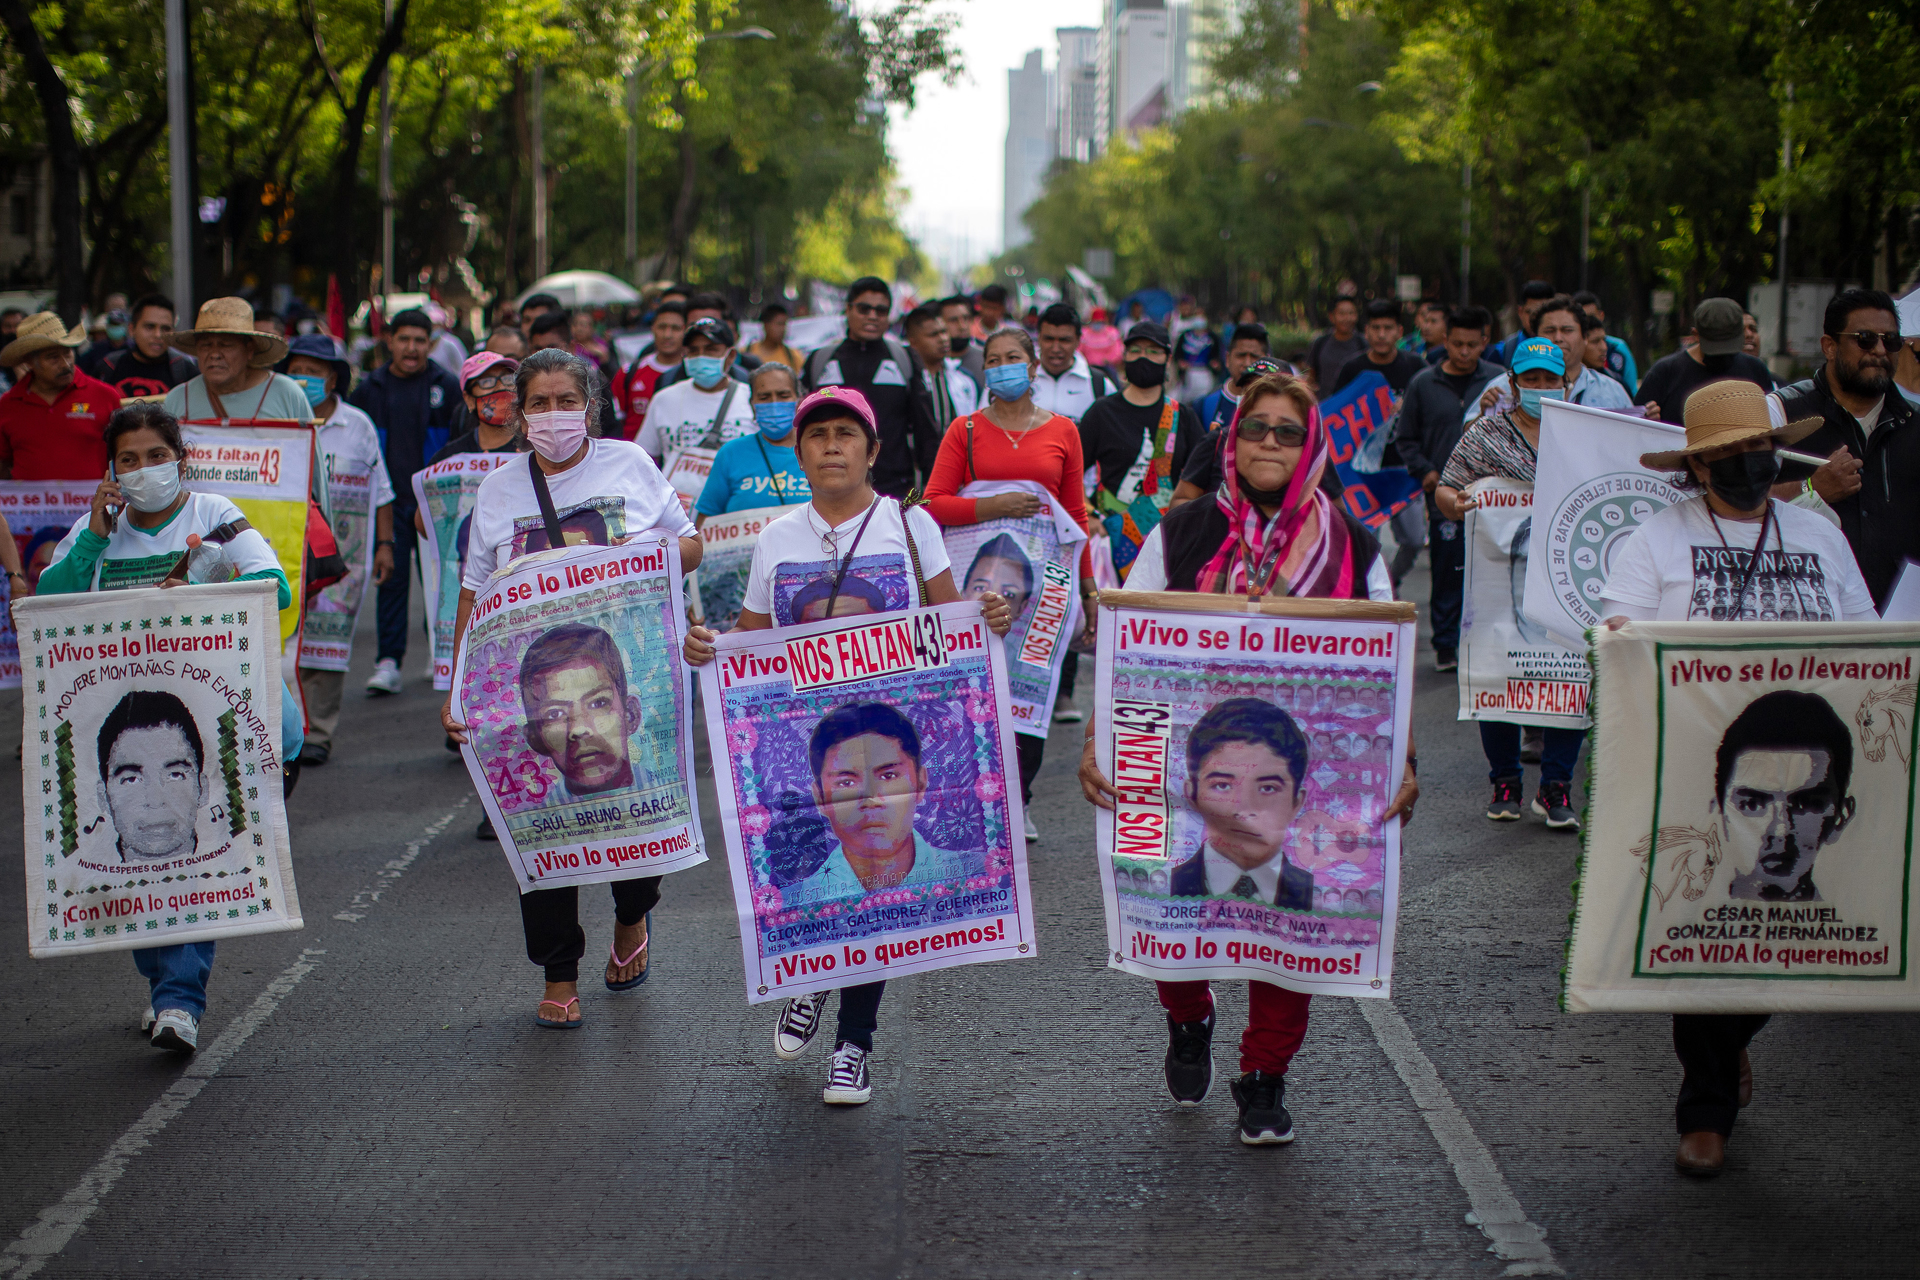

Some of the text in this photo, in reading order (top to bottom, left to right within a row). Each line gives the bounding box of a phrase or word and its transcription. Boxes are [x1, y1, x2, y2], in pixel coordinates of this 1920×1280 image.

[186, 465, 258, 482] Dónde están
[187, 448, 280, 485] Nos faltan 43
[325, 453, 336, 483] 3!
[329, 472, 370, 487] varon!
[425, 459, 489, 479] ¡Vivo se
[677, 460, 711, 476] ¡Vivo
[22, 490, 41, 507] se
[45, 491, 58, 507] lo
[63, 490, 94, 507] lleva
[1478, 489, 1517, 509] ¡Vivo
[744, 521, 761, 536] se
[470, 548, 664, 630] ¡Vivo se lo llevaron!
[1044, 561, 1071, 587] 43!
[577, 598, 602, 610] quiero
[604, 590, 625, 603] saber
[628, 586, 647, 597] dónde
[649, 584, 665, 594] está
[1037, 584, 1069, 635] FALTAN
[48, 631, 233, 669] ¡Vivo se lo llevaron!
[787, 637, 834, 687] NOS
[835, 622, 915, 679] FALTAN
[914, 612, 948, 669] 43!
[1021, 634, 1052, 667] NOS
[1120, 618, 1393, 658] ¡Vivo se lo llevaron!
[1507, 651, 1558, 659] MIGUEL
[722, 654, 788, 688] ¡Vivo
[1516, 661, 1588, 669] HERNÁNDE
[1523, 670, 1591, 679] MARTÍNEZ
[1672, 656, 1911, 686] ¡Vivo se lo llevaron!
[744, 693, 760, 703] Jan
[764, 690, 792, 702] Nimmo,
[879, 675, 907, 687] quiero
[912, 671, 935, 680] saber
[939, 667, 963, 678] dónde
[968, 664, 987, 674] está
[1475, 691, 1505, 710] ¡Con
[1506, 681, 1534, 711] NOS
[1537, 682, 1587, 714] FALTAN
[54, 659, 279, 775] MOVERE MONTAÑAS POR ENCONTRARTE
[1113, 699, 1170, 734] 43!
[497, 760, 548, 799] 43
[1116, 732, 1163, 807] FALTAN
[532, 814, 570, 834] SAÚL
[576, 807, 622, 827] BRUNO
[630, 794, 677, 818] GARCÍA
[1117, 812, 1164, 857] NOS
[78, 841, 231, 875] NUNCA ESPERES QUE TE OLVIDEMOS
[534, 827, 691, 877] ¡Vivo lo queremos!
[63, 882, 255, 928] ¡Con VIDA lo queremos!
[768, 889, 1008, 943] GIOVANNI GALINDREZ GUERRERO
[1161, 899, 1328, 935] JORGE ÁLVAREZ NAVA
[1704, 904, 1843, 924] CÉSAR MANUEL
[769, 904, 1008, 954] Hijo de José Alfredo y María Elena 19 años Arcelia
[1155, 922, 1194, 931] Epifanio
[1206, 922, 1236, 930] Blanca
[1667, 922, 1878, 942] GONZÁLEZ HERNÁNDEZ
[774, 919, 1005, 985] ¡Vivo lo queremos!
[1132, 931, 1361, 976] ¡Vivo lo queremos!
[1649, 943, 1889, 969] ¡Con VIDA lo queremos!
